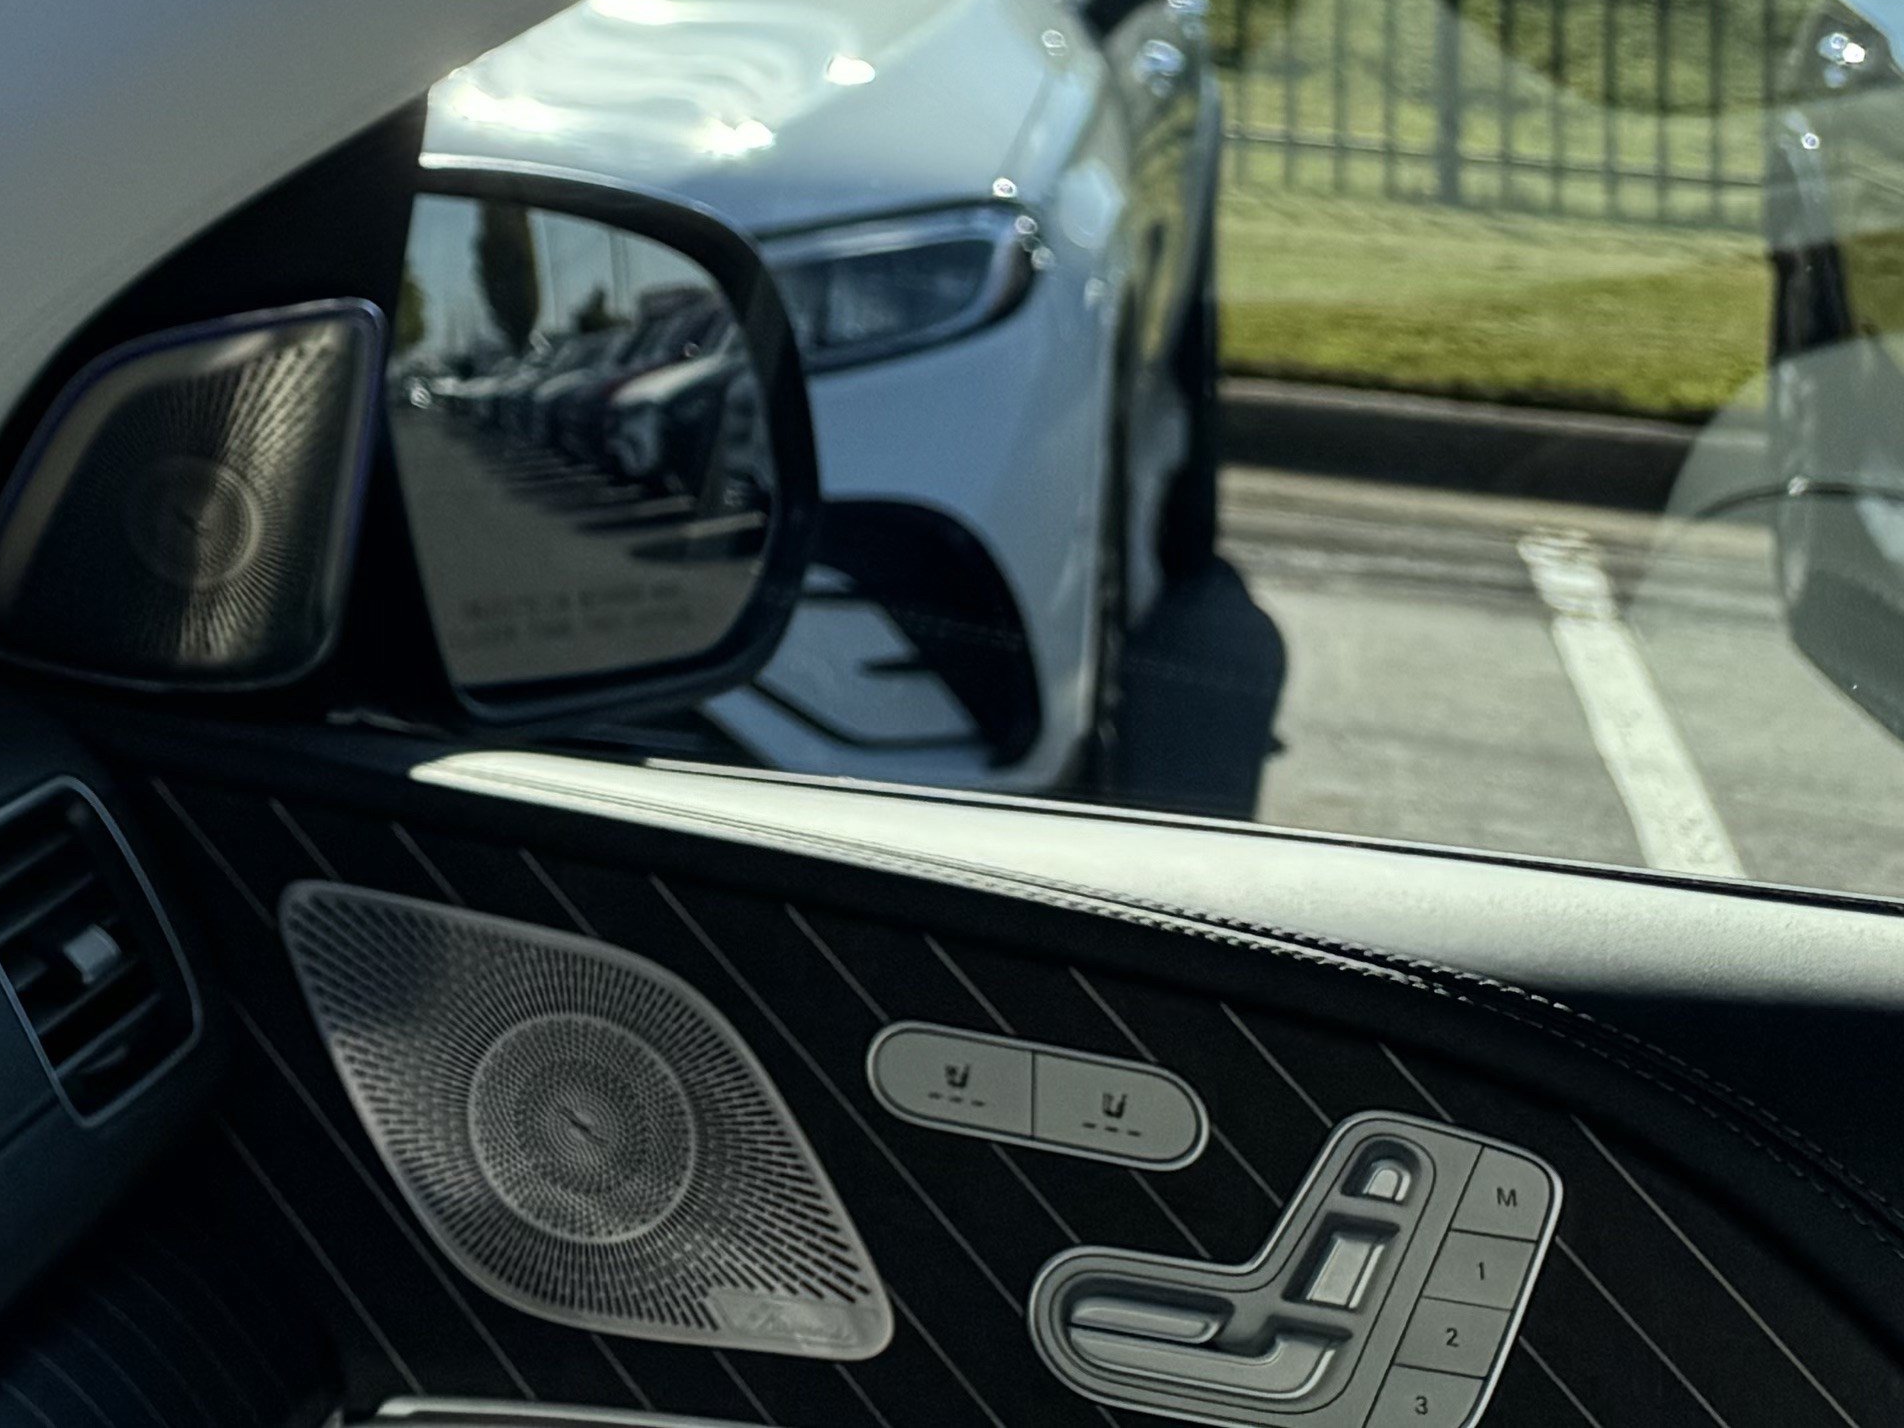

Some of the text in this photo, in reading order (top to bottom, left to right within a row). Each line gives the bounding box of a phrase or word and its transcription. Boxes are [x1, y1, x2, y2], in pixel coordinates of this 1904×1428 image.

[1496, 1186, 1518, 1208] M
[1478, 1261, 1486, 1281] 1
[1445, 1327, 1461, 1348] 2
[1414, 1395, 1429, 1415] 3
